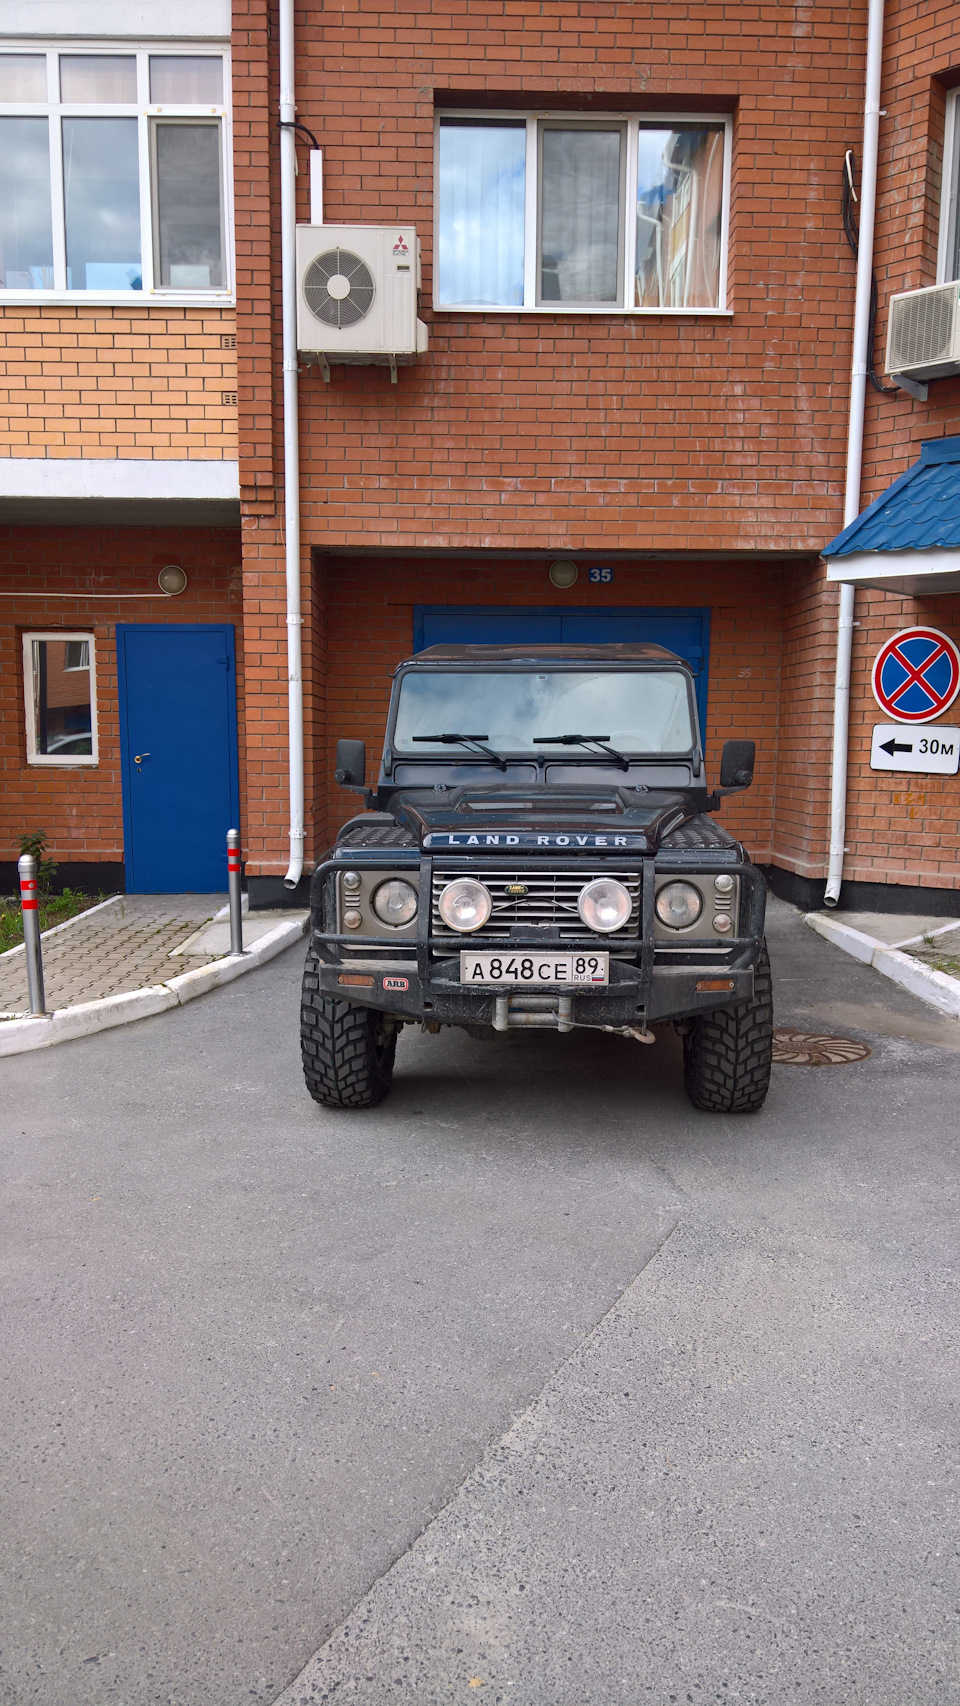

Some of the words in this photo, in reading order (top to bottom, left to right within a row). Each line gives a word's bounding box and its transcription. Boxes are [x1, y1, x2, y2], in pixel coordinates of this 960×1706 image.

[590, 569, 611, 582] 35
[448, 835, 520, 845] LAND
[537, 835, 627, 846] ROVER
[575, 957, 599, 975] 89
[573, 974, 591, 982] RUS
